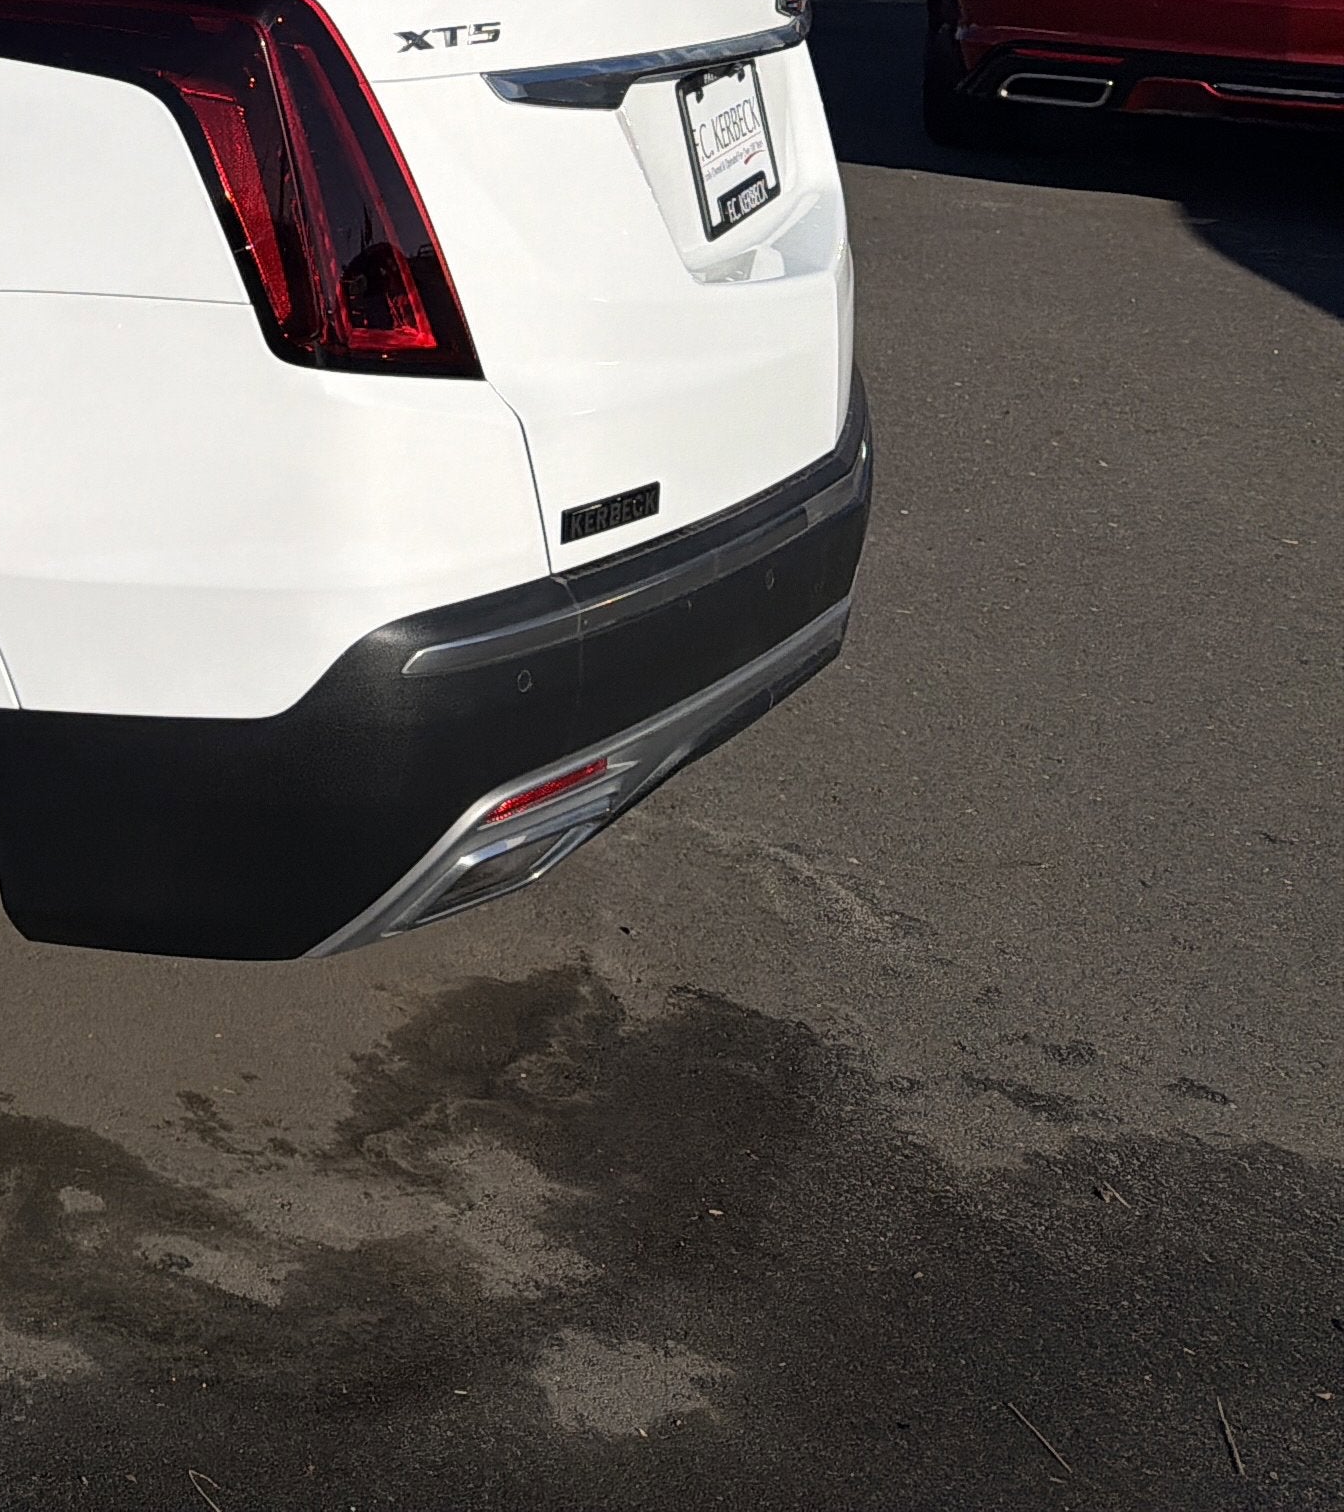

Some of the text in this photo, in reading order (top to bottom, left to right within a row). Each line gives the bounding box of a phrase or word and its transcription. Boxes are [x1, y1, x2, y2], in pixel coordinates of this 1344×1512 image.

[393, 21, 502, 53] XT5
[693, 96, 760, 162] .C. KERBECK
[570, 489, 658, 538] KERBECK
